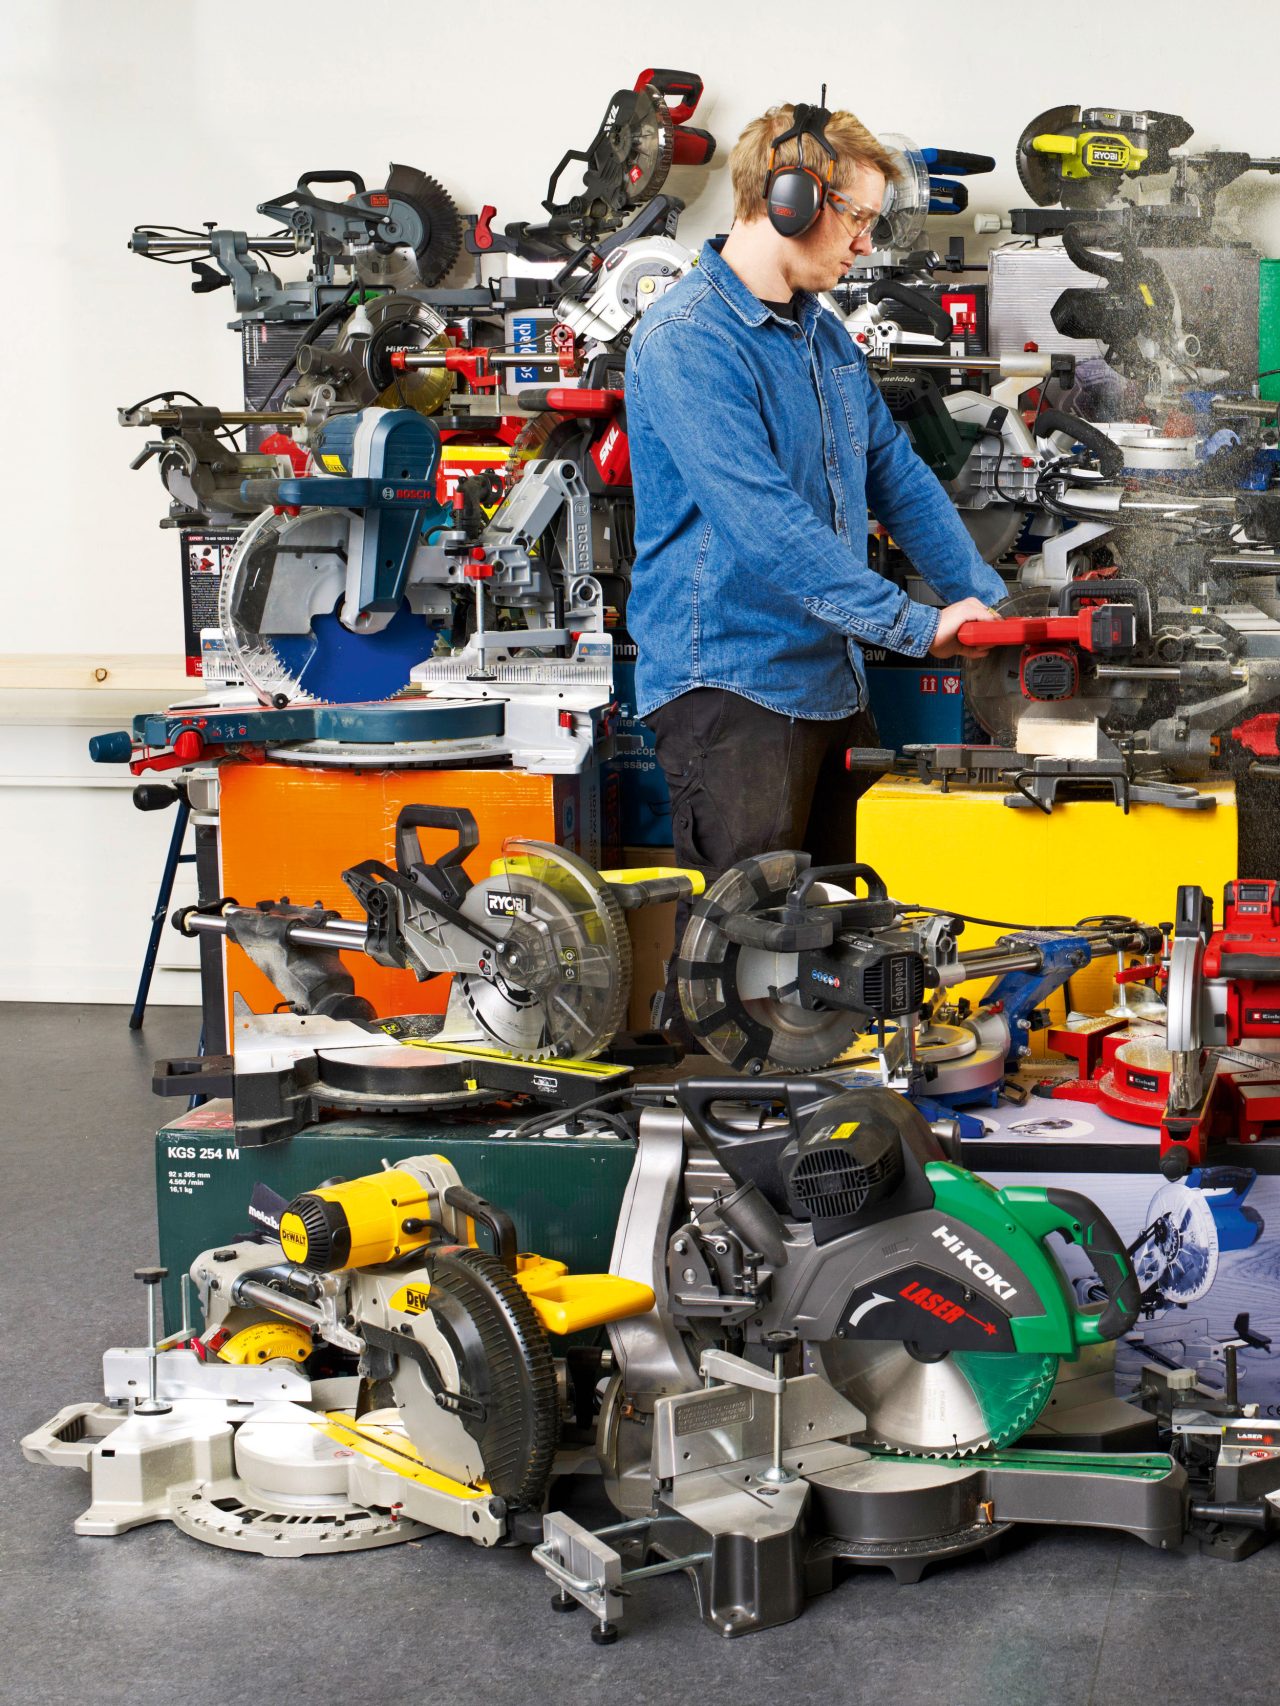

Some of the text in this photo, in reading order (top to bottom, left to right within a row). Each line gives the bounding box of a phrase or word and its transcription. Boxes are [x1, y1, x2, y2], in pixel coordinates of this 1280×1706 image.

[1094, 151, 1118, 160] RYOBI
[600, 427, 620, 465] SKIL
[396, 490, 431, 499] BOSCH
[576, 524, 589, 571] BOSCH
[892, 962, 907, 1006] scheppach
[168, 1146, 240, 1160] KGS 254 M
[900, 1282, 966, 1325] LASER
